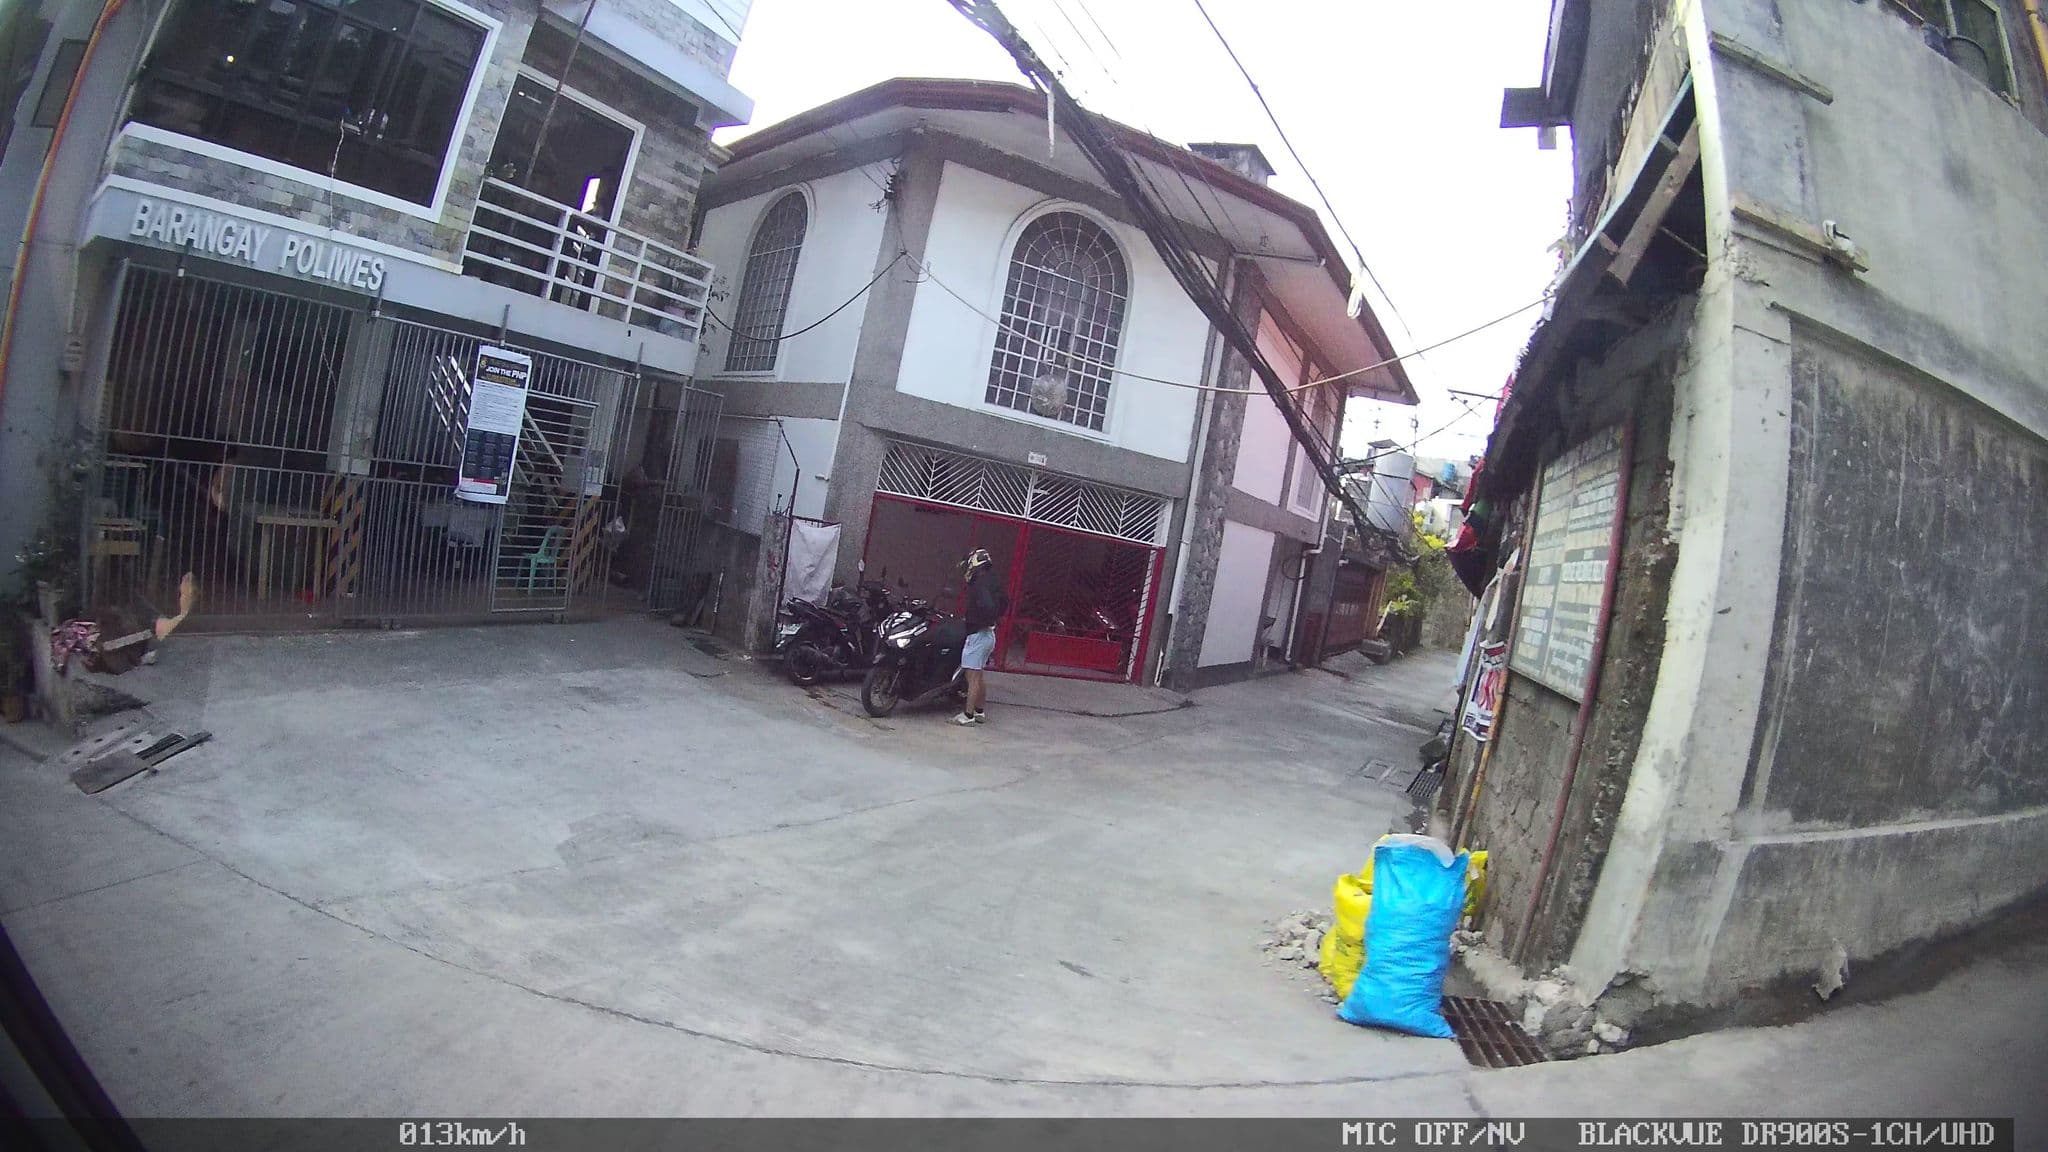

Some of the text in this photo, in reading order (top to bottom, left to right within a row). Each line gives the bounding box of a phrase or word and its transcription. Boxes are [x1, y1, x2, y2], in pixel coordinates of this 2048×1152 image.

[131, 200, 385, 291] BARANGAY POLIWES
[486, 366, 500, 374] JOIN
[500, 368, 512, 377] THE
